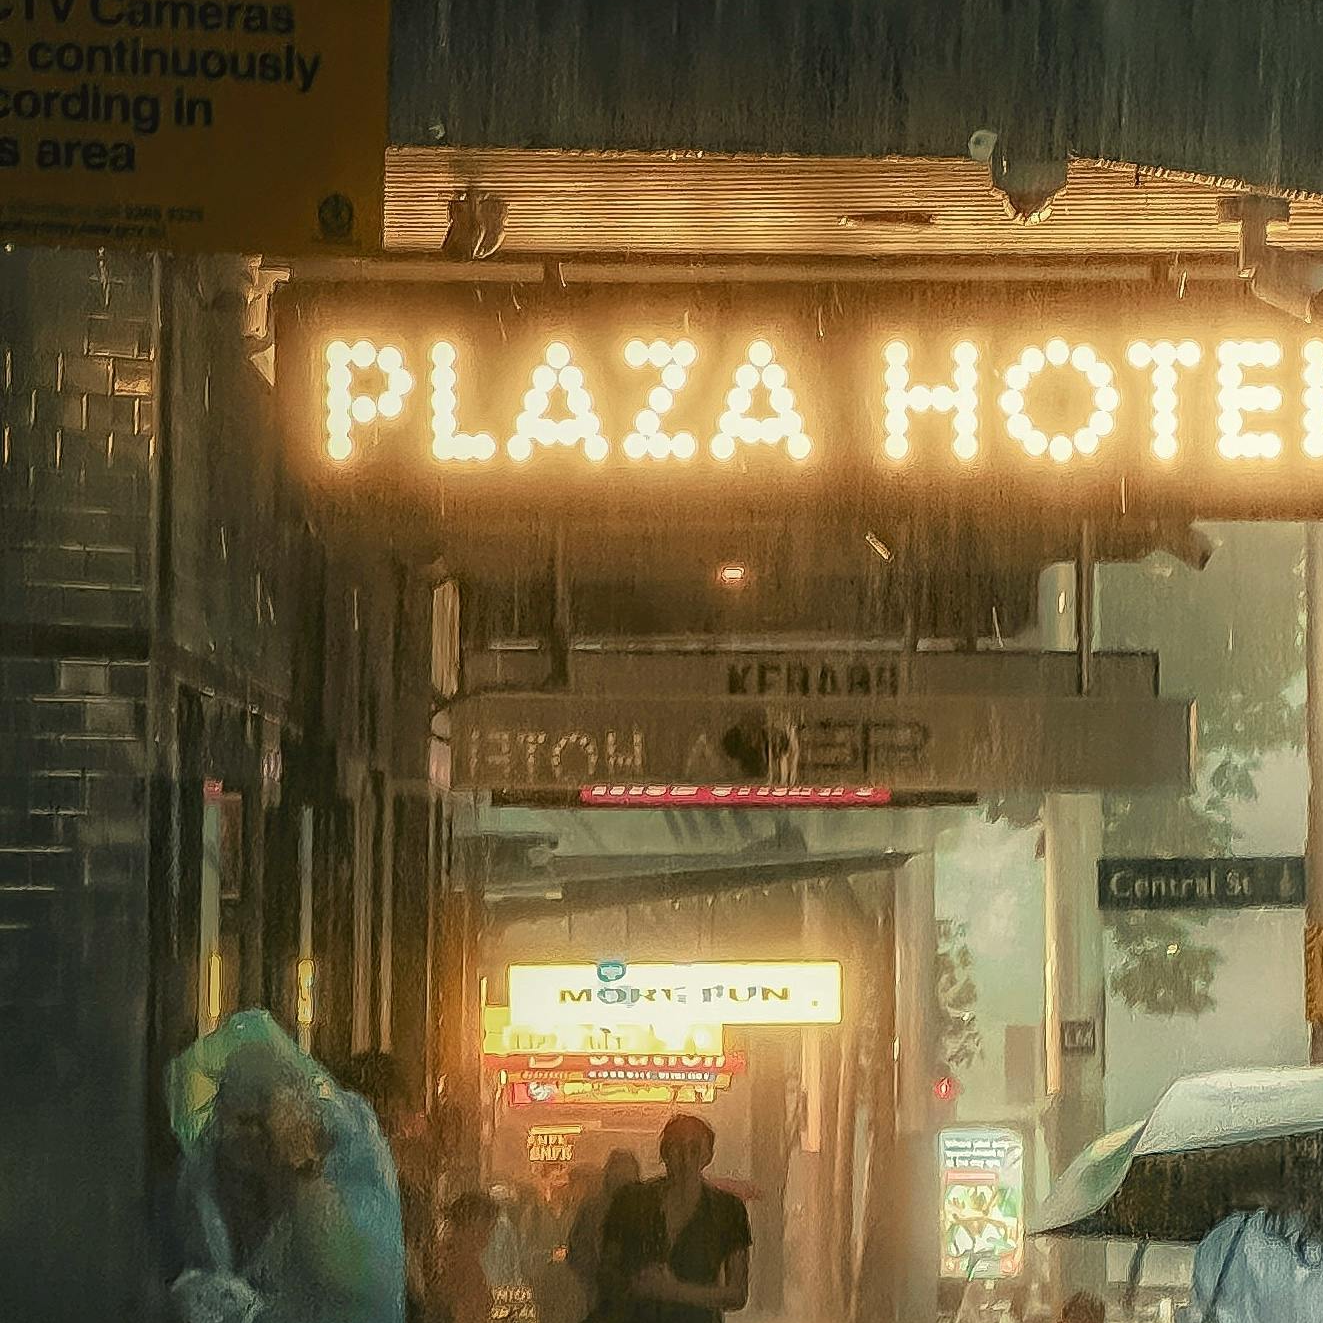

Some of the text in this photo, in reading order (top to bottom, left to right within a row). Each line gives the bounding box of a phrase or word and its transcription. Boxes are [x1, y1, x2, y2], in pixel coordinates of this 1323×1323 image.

[28, 37, 322, 93] continuously
[174, 88, 213, 128] in
[37, 138, 136, 174] area
[326, 340, 812, 461] PLAZA
[560, 986, 687, 1004] MORE
